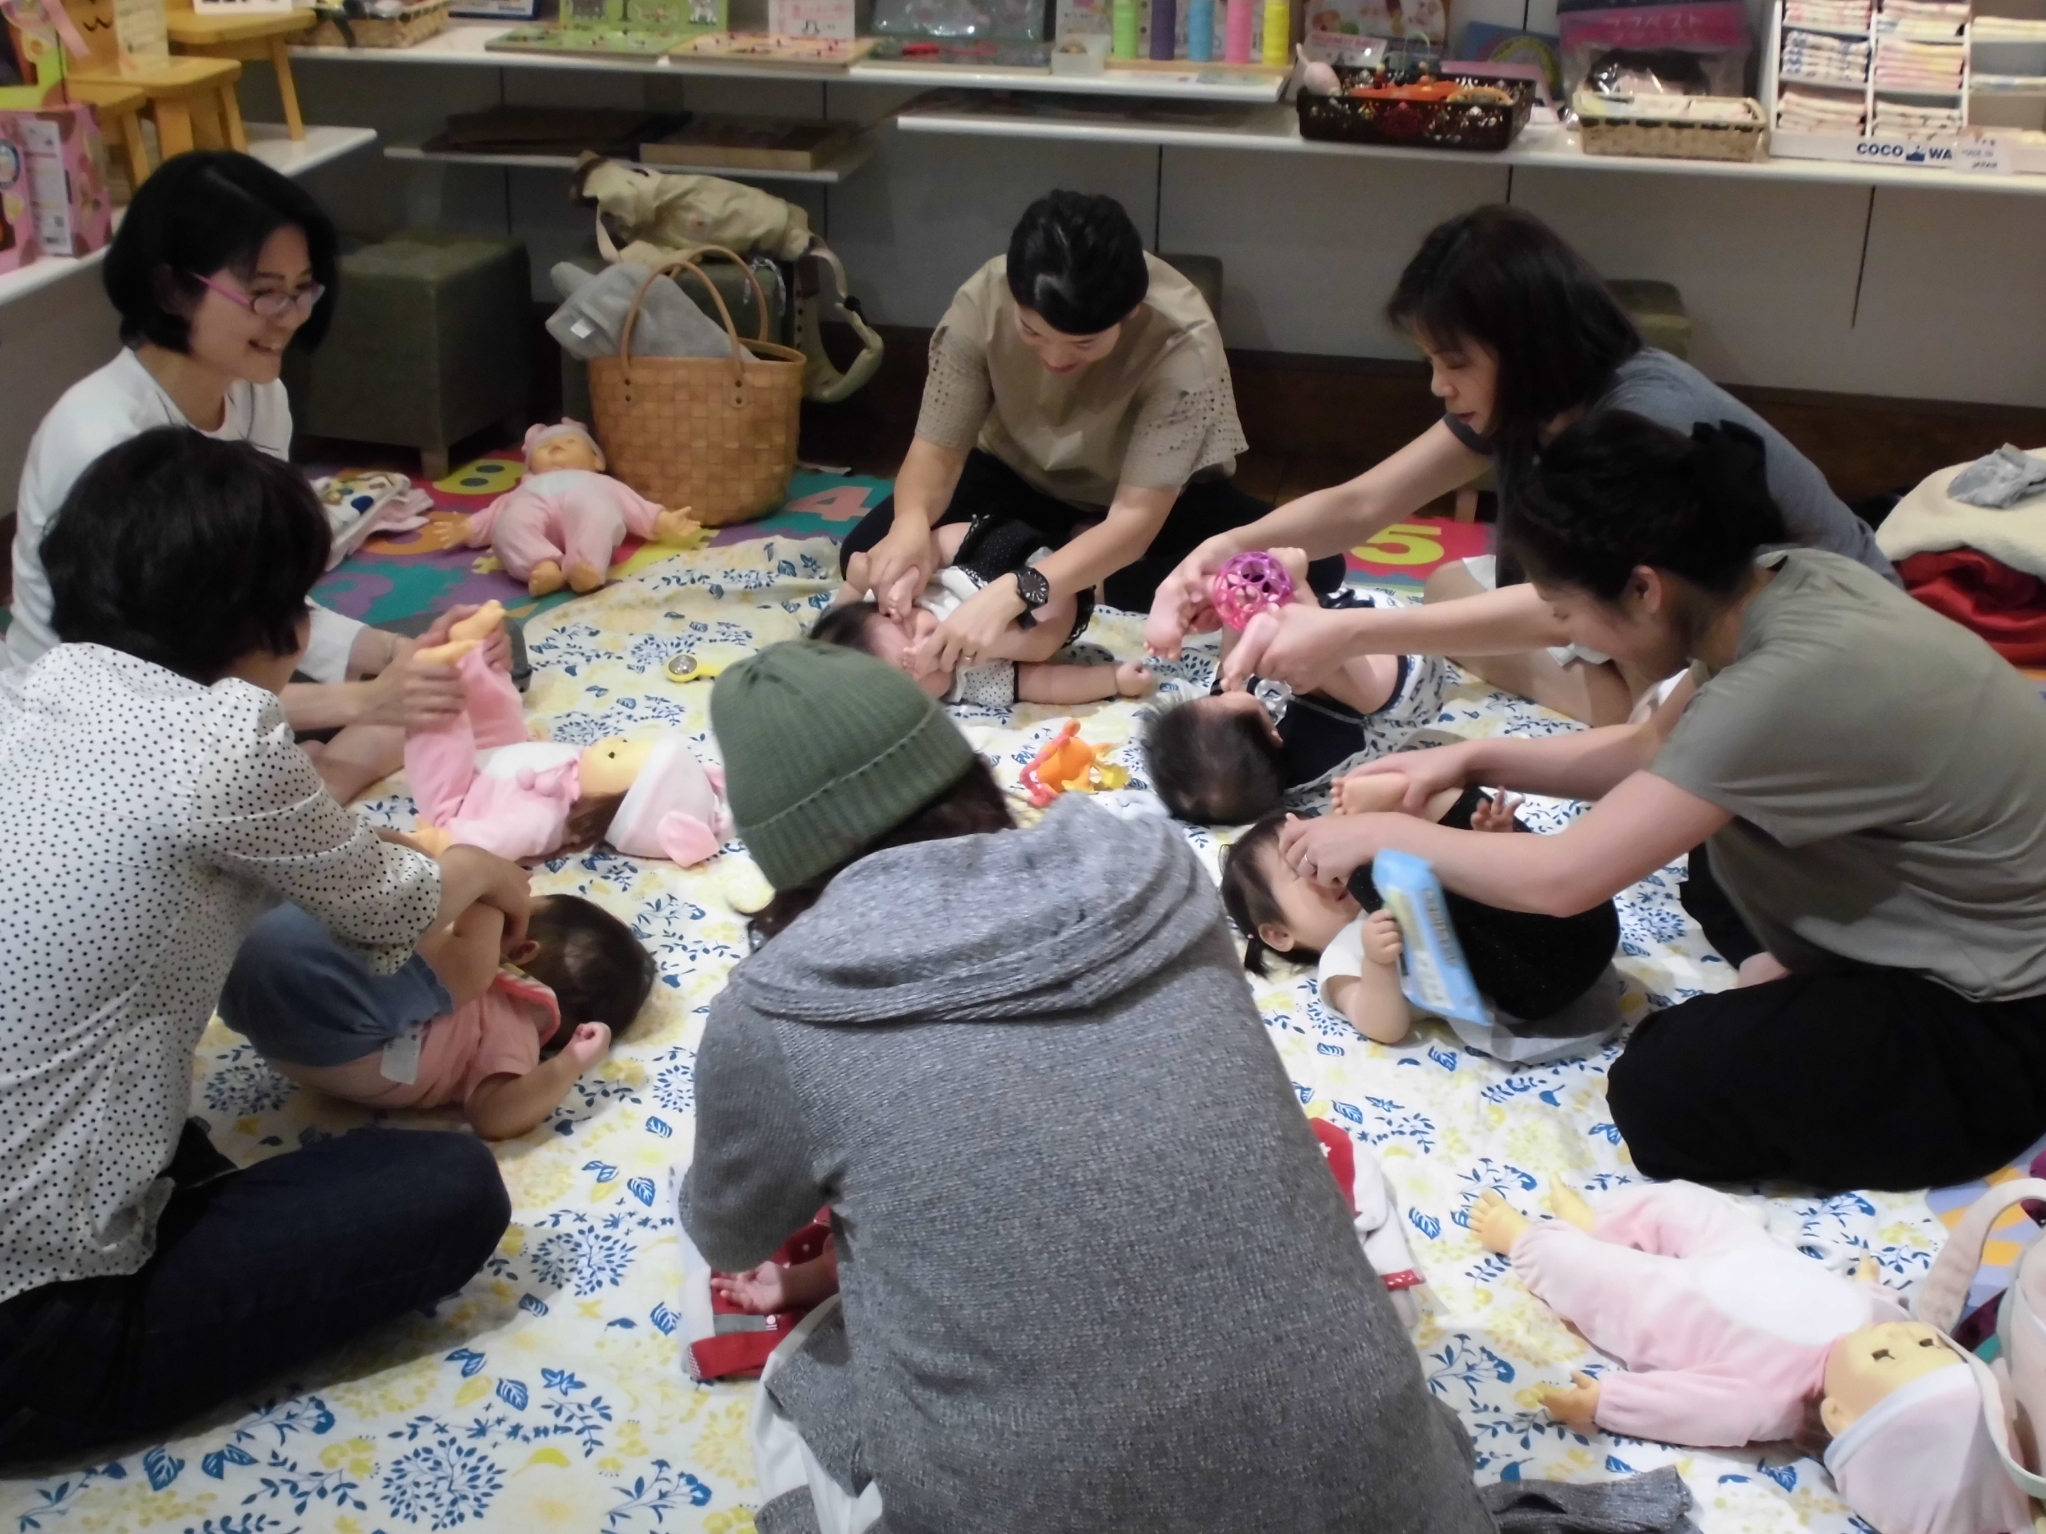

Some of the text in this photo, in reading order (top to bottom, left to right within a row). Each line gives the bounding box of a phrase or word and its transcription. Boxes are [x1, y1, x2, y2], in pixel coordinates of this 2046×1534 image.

[1856, 142, 1904, 157] COCO
[782, 485, 874, 522] 4
[1349, 523, 1445, 566] 5
